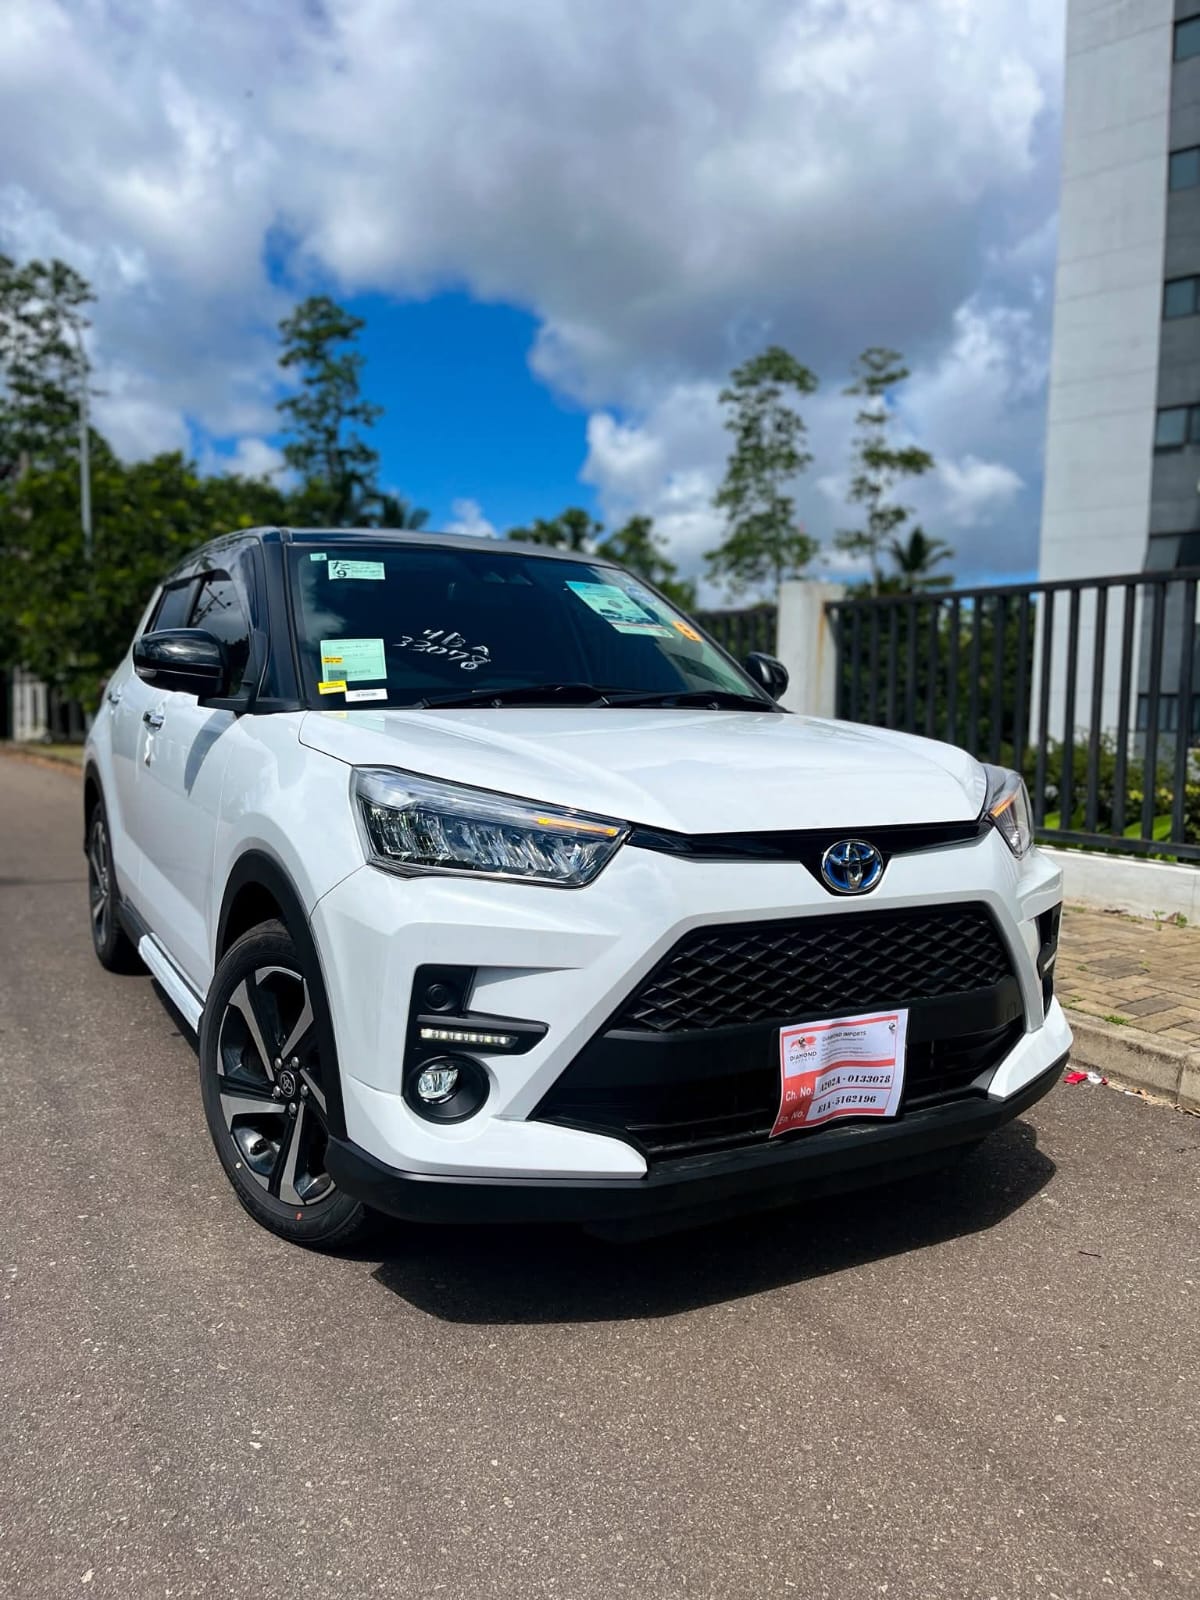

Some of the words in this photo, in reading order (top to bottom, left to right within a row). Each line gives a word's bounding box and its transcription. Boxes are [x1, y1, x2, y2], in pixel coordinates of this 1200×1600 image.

[790, 1051, 817, 1061] DIAMOND
[847, 1074, 891, 1083] 0133078
[785, 1090, 798, 1102] Ch.
[800, 1086, 814, 1097] No.
[791, 1110, 805, 1120] No.
